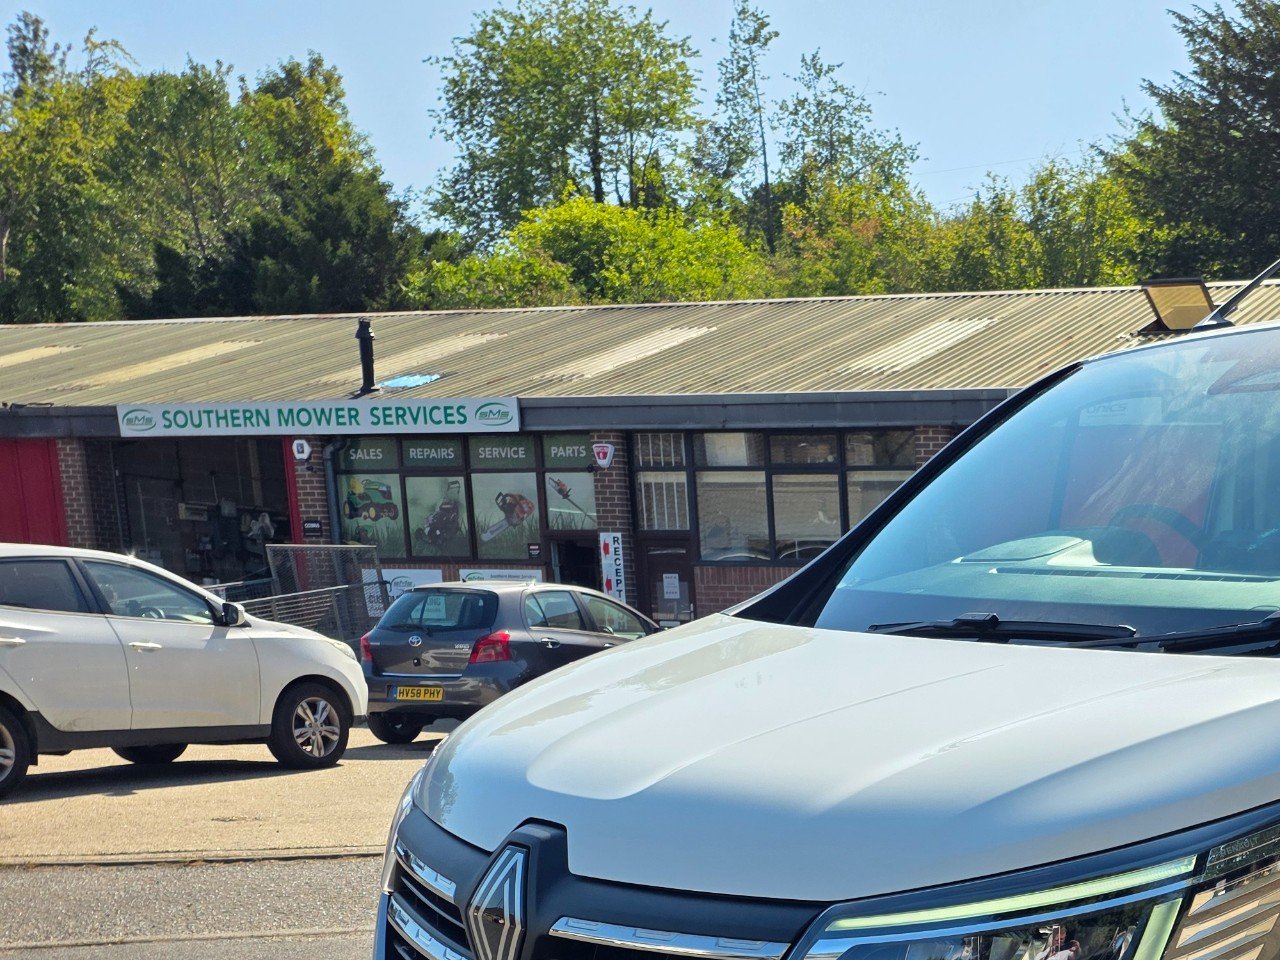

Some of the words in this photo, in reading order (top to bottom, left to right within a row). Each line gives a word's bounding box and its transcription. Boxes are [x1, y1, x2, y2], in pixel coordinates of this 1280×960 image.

[161, 409, 271, 429] SOUTHERN
[277, 407, 361, 427] MOWER
[369, 405, 468, 426] SERVICES
[349, 449, 383, 460] SALES
[409, 447, 455, 459] REPAIRS
[478, 447, 526, 458] SERVICE
[551, 445, 586, 457] PARTS
[398, 688, 422, 698] HV58
[423, 688, 441, 699] PHY
